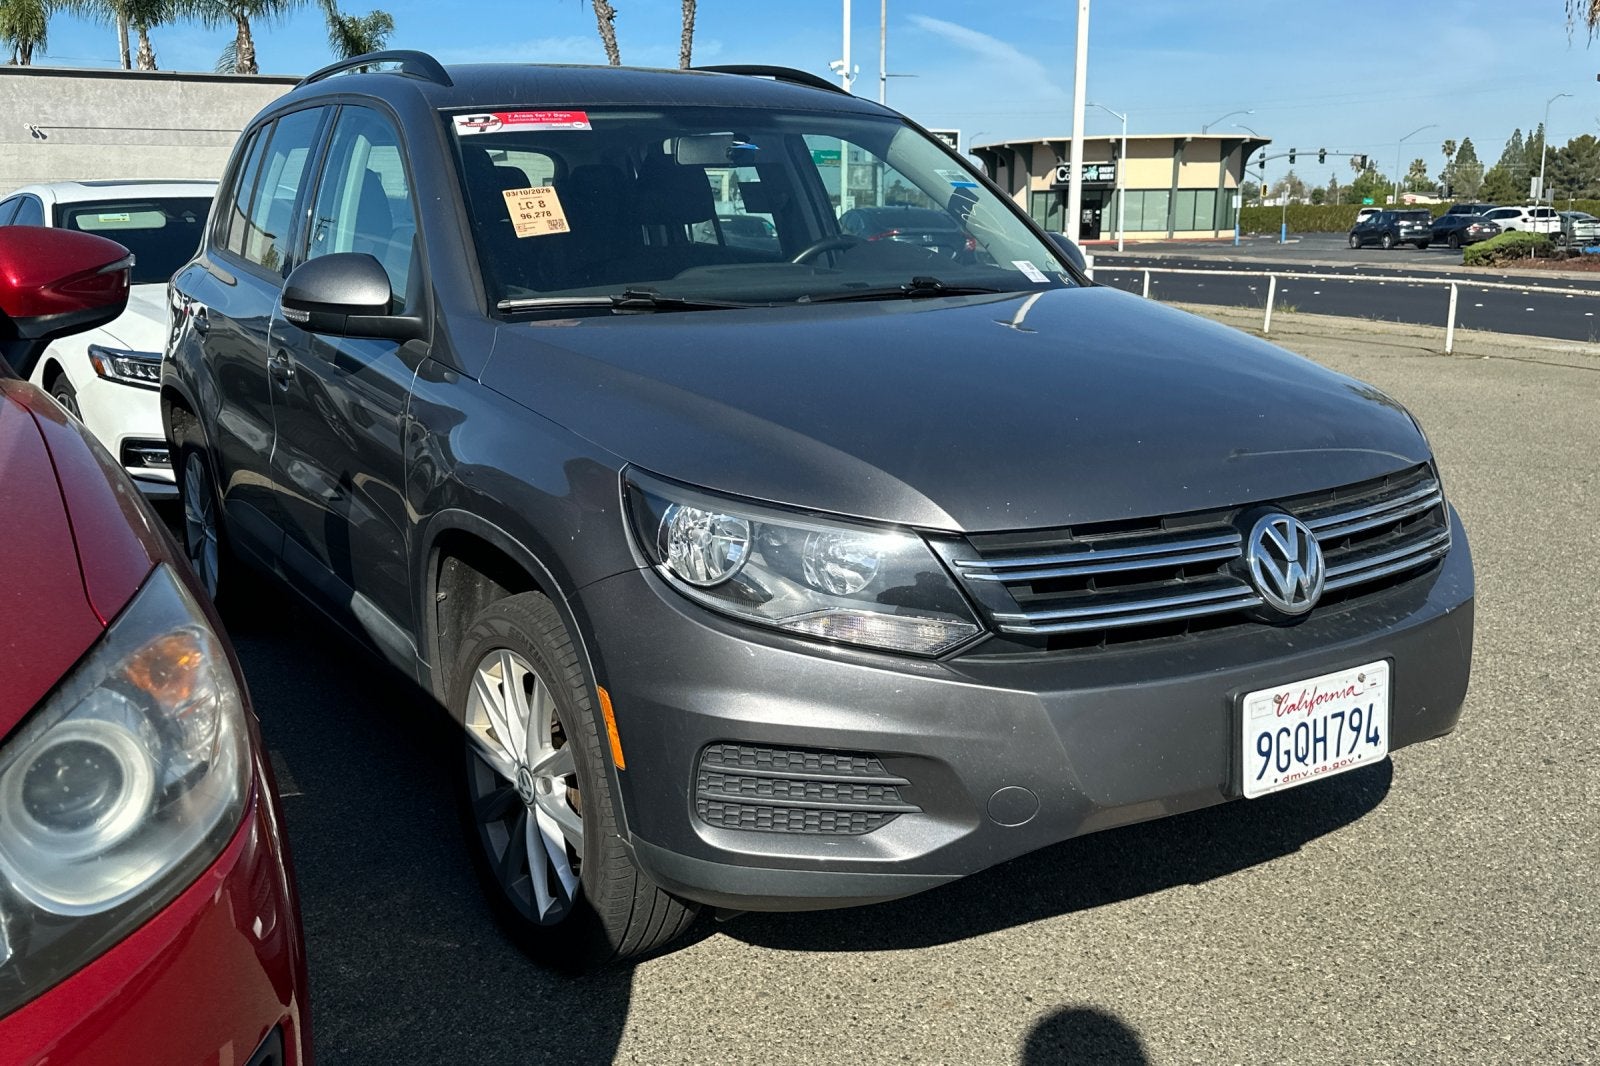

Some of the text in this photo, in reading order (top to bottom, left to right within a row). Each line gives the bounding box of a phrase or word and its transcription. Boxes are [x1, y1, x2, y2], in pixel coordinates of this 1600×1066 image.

[505, 188, 551, 197] 03/10/2026
[518, 200, 546, 210] LC 8
[520, 210, 552, 220] 96,278
[1276, 685, 1364, 717] California
[1256, 703, 1380, 780] 9GQH794
[1282, 757, 1355, 783] dmv.ca.gov
